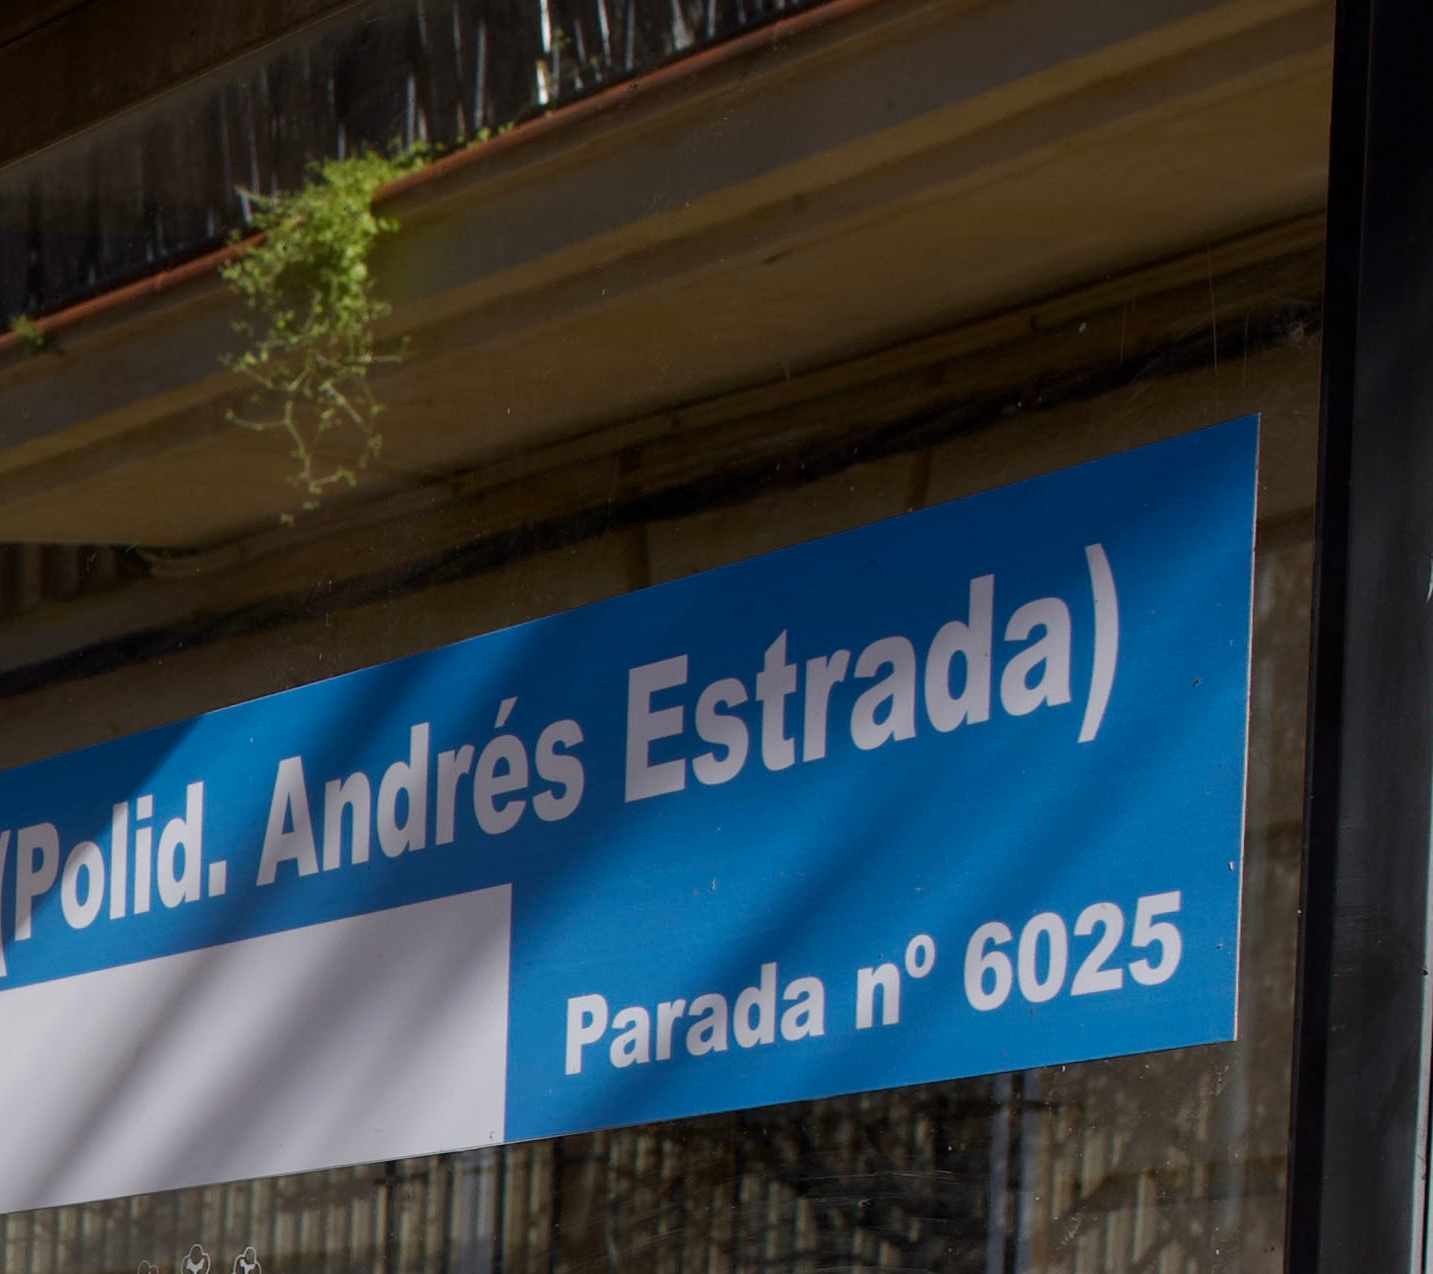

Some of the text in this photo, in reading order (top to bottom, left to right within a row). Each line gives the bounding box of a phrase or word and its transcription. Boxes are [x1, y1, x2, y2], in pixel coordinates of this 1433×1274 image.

[256, 697, 584, 886] Andrés
[624, 543, 1119, 803] Estrada)
[565, 963, 825, 1074] Parada
[965, 890, 1182, 1010] 6025
